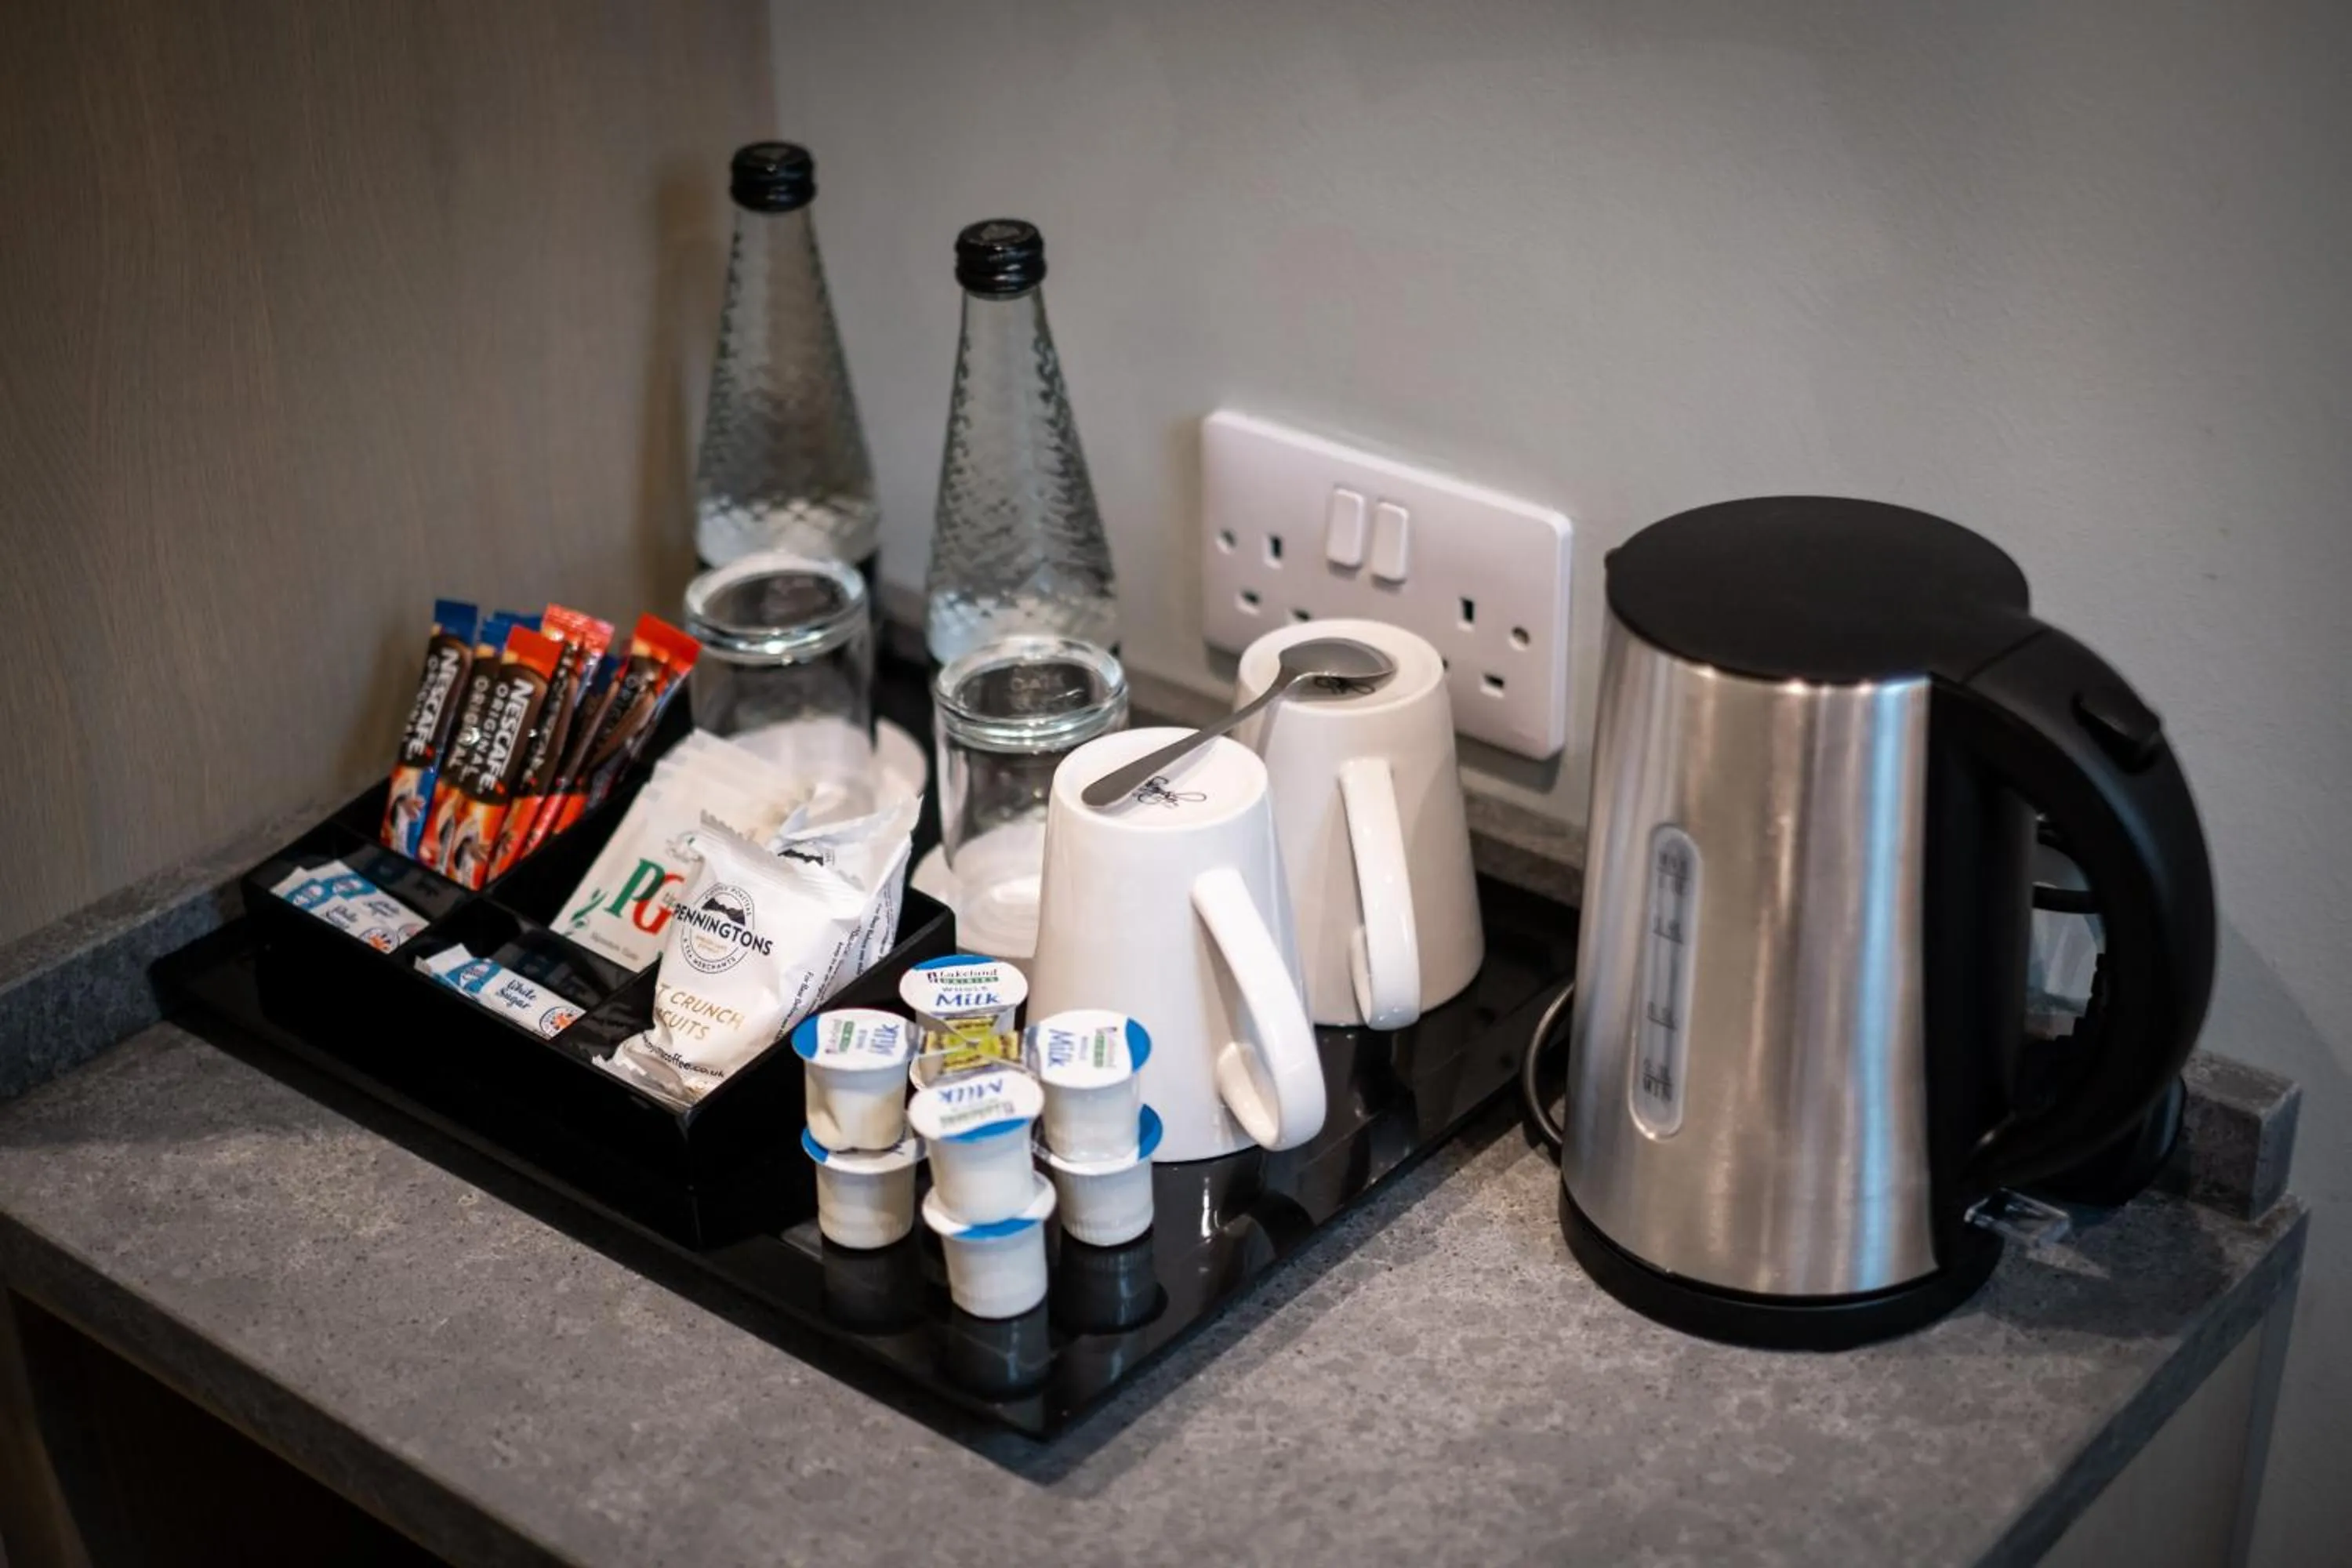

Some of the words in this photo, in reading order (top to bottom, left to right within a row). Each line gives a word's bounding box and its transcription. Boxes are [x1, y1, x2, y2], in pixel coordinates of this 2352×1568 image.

[459, 681, 509, 783] ORIGINAL
[603, 857, 685, 936] PG
[674, 902, 773, 956] PENNINGTONS
[670, 990, 745, 1032] CRUNCH
[935, 993, 1000, 1007] Milk
